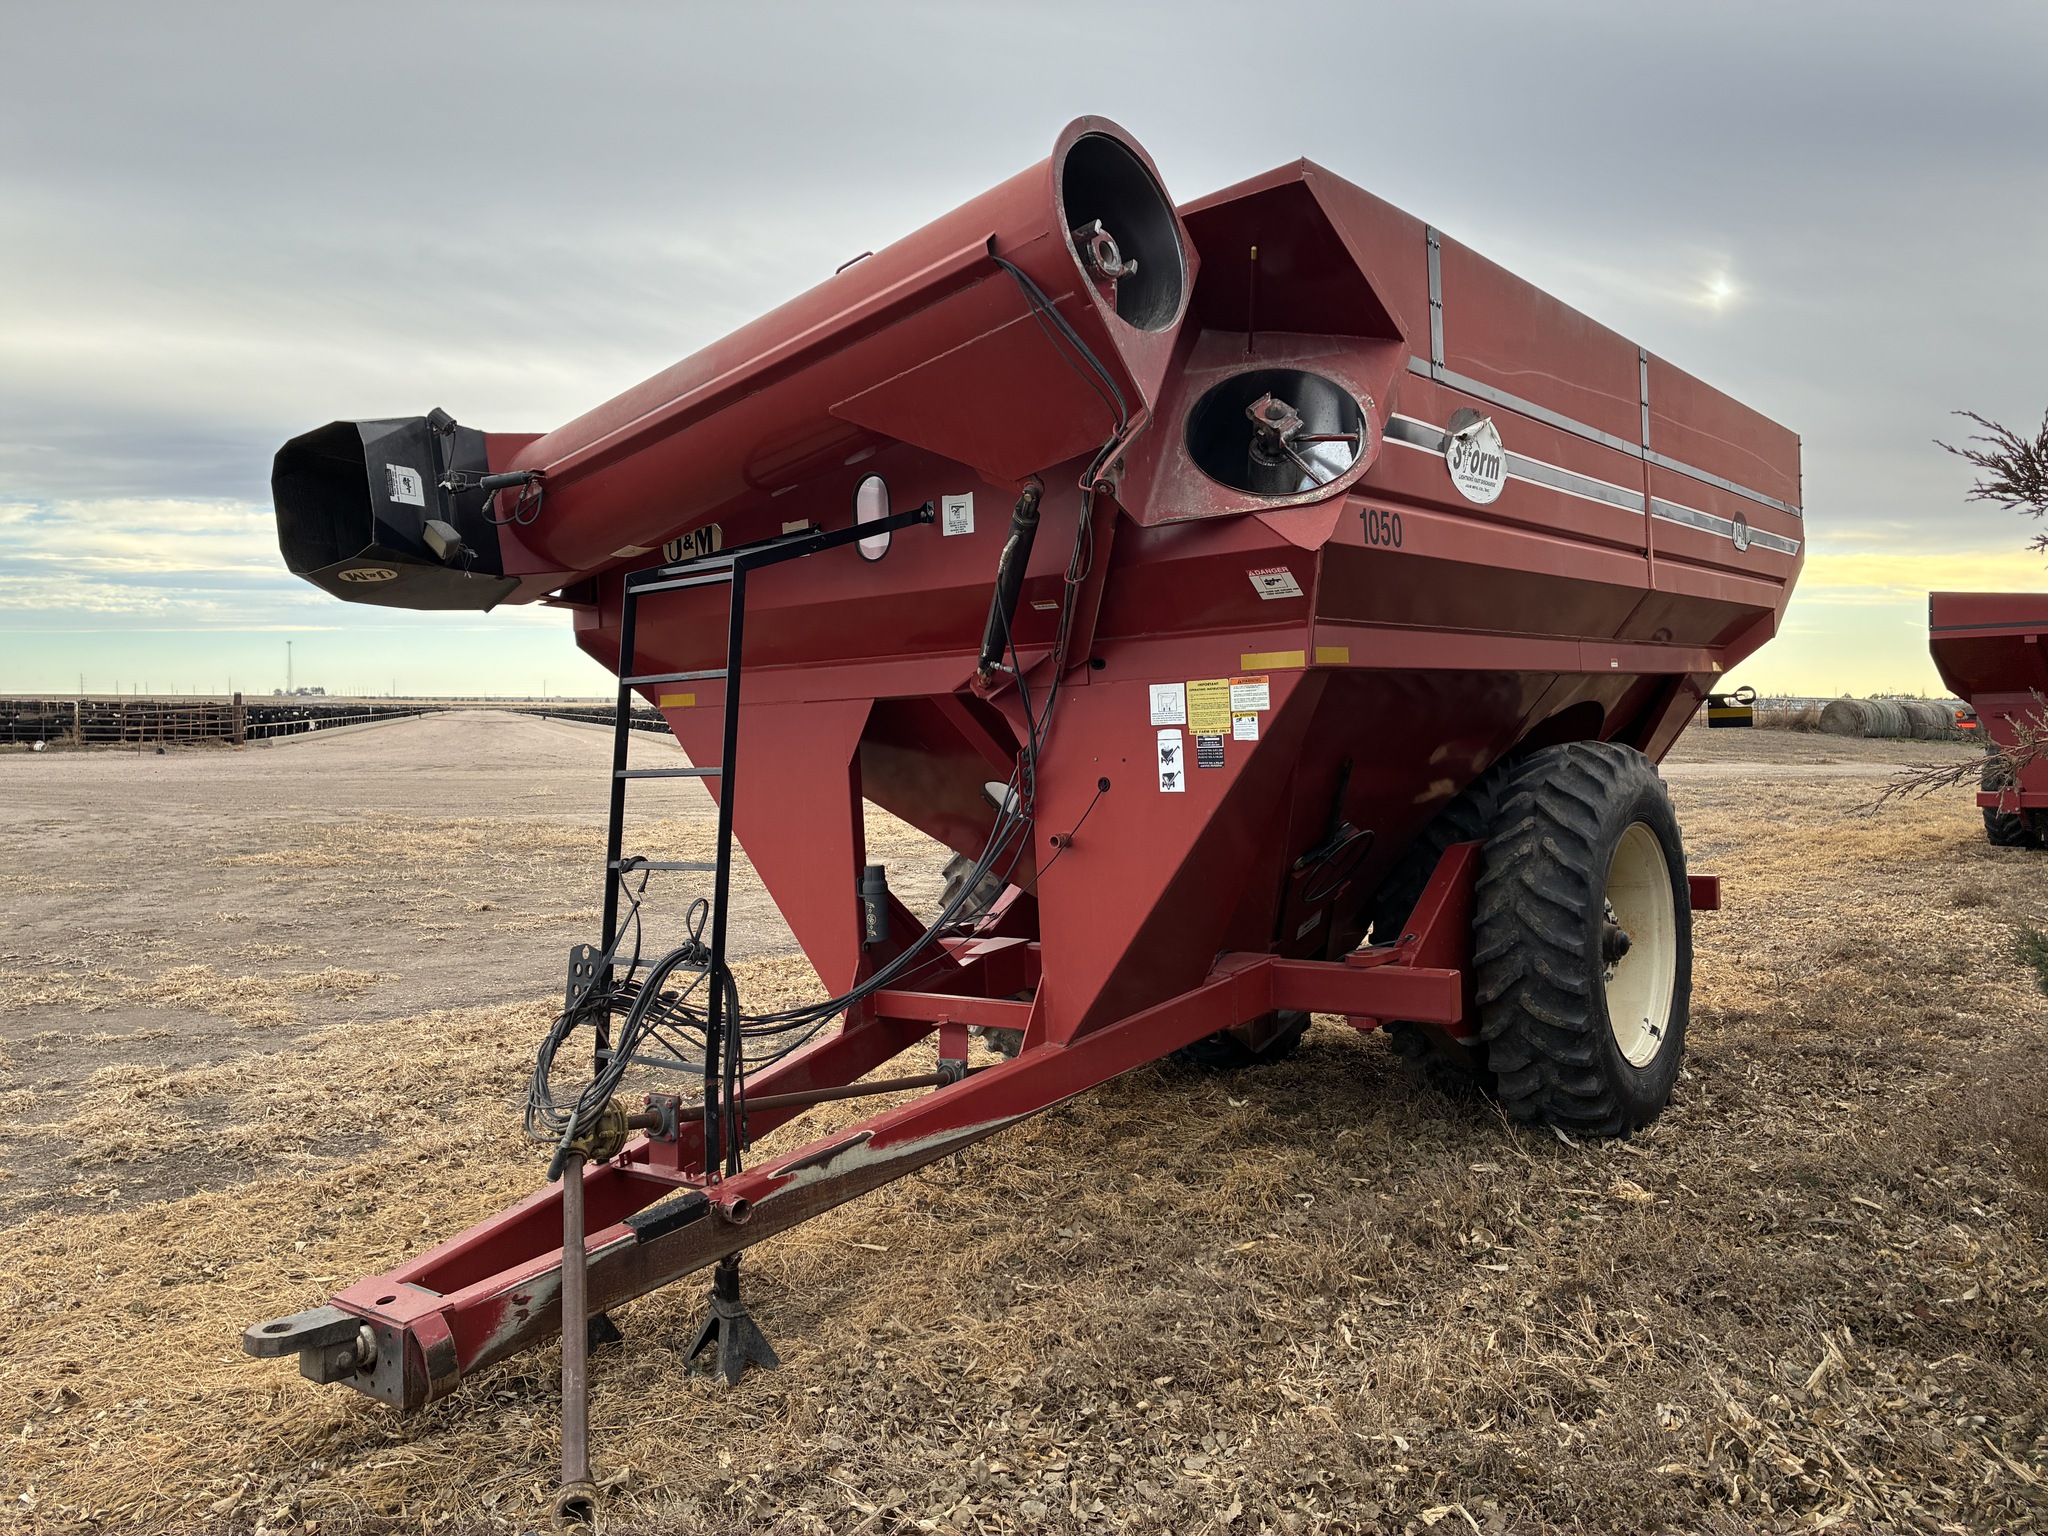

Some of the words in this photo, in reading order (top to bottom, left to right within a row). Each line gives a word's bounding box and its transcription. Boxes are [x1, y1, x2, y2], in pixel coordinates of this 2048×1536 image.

[1453, 442, 1500, 480] Storm
[1360, 508, 1402, 547] 1050
[1255, 566, 1289, 575] DANGER
